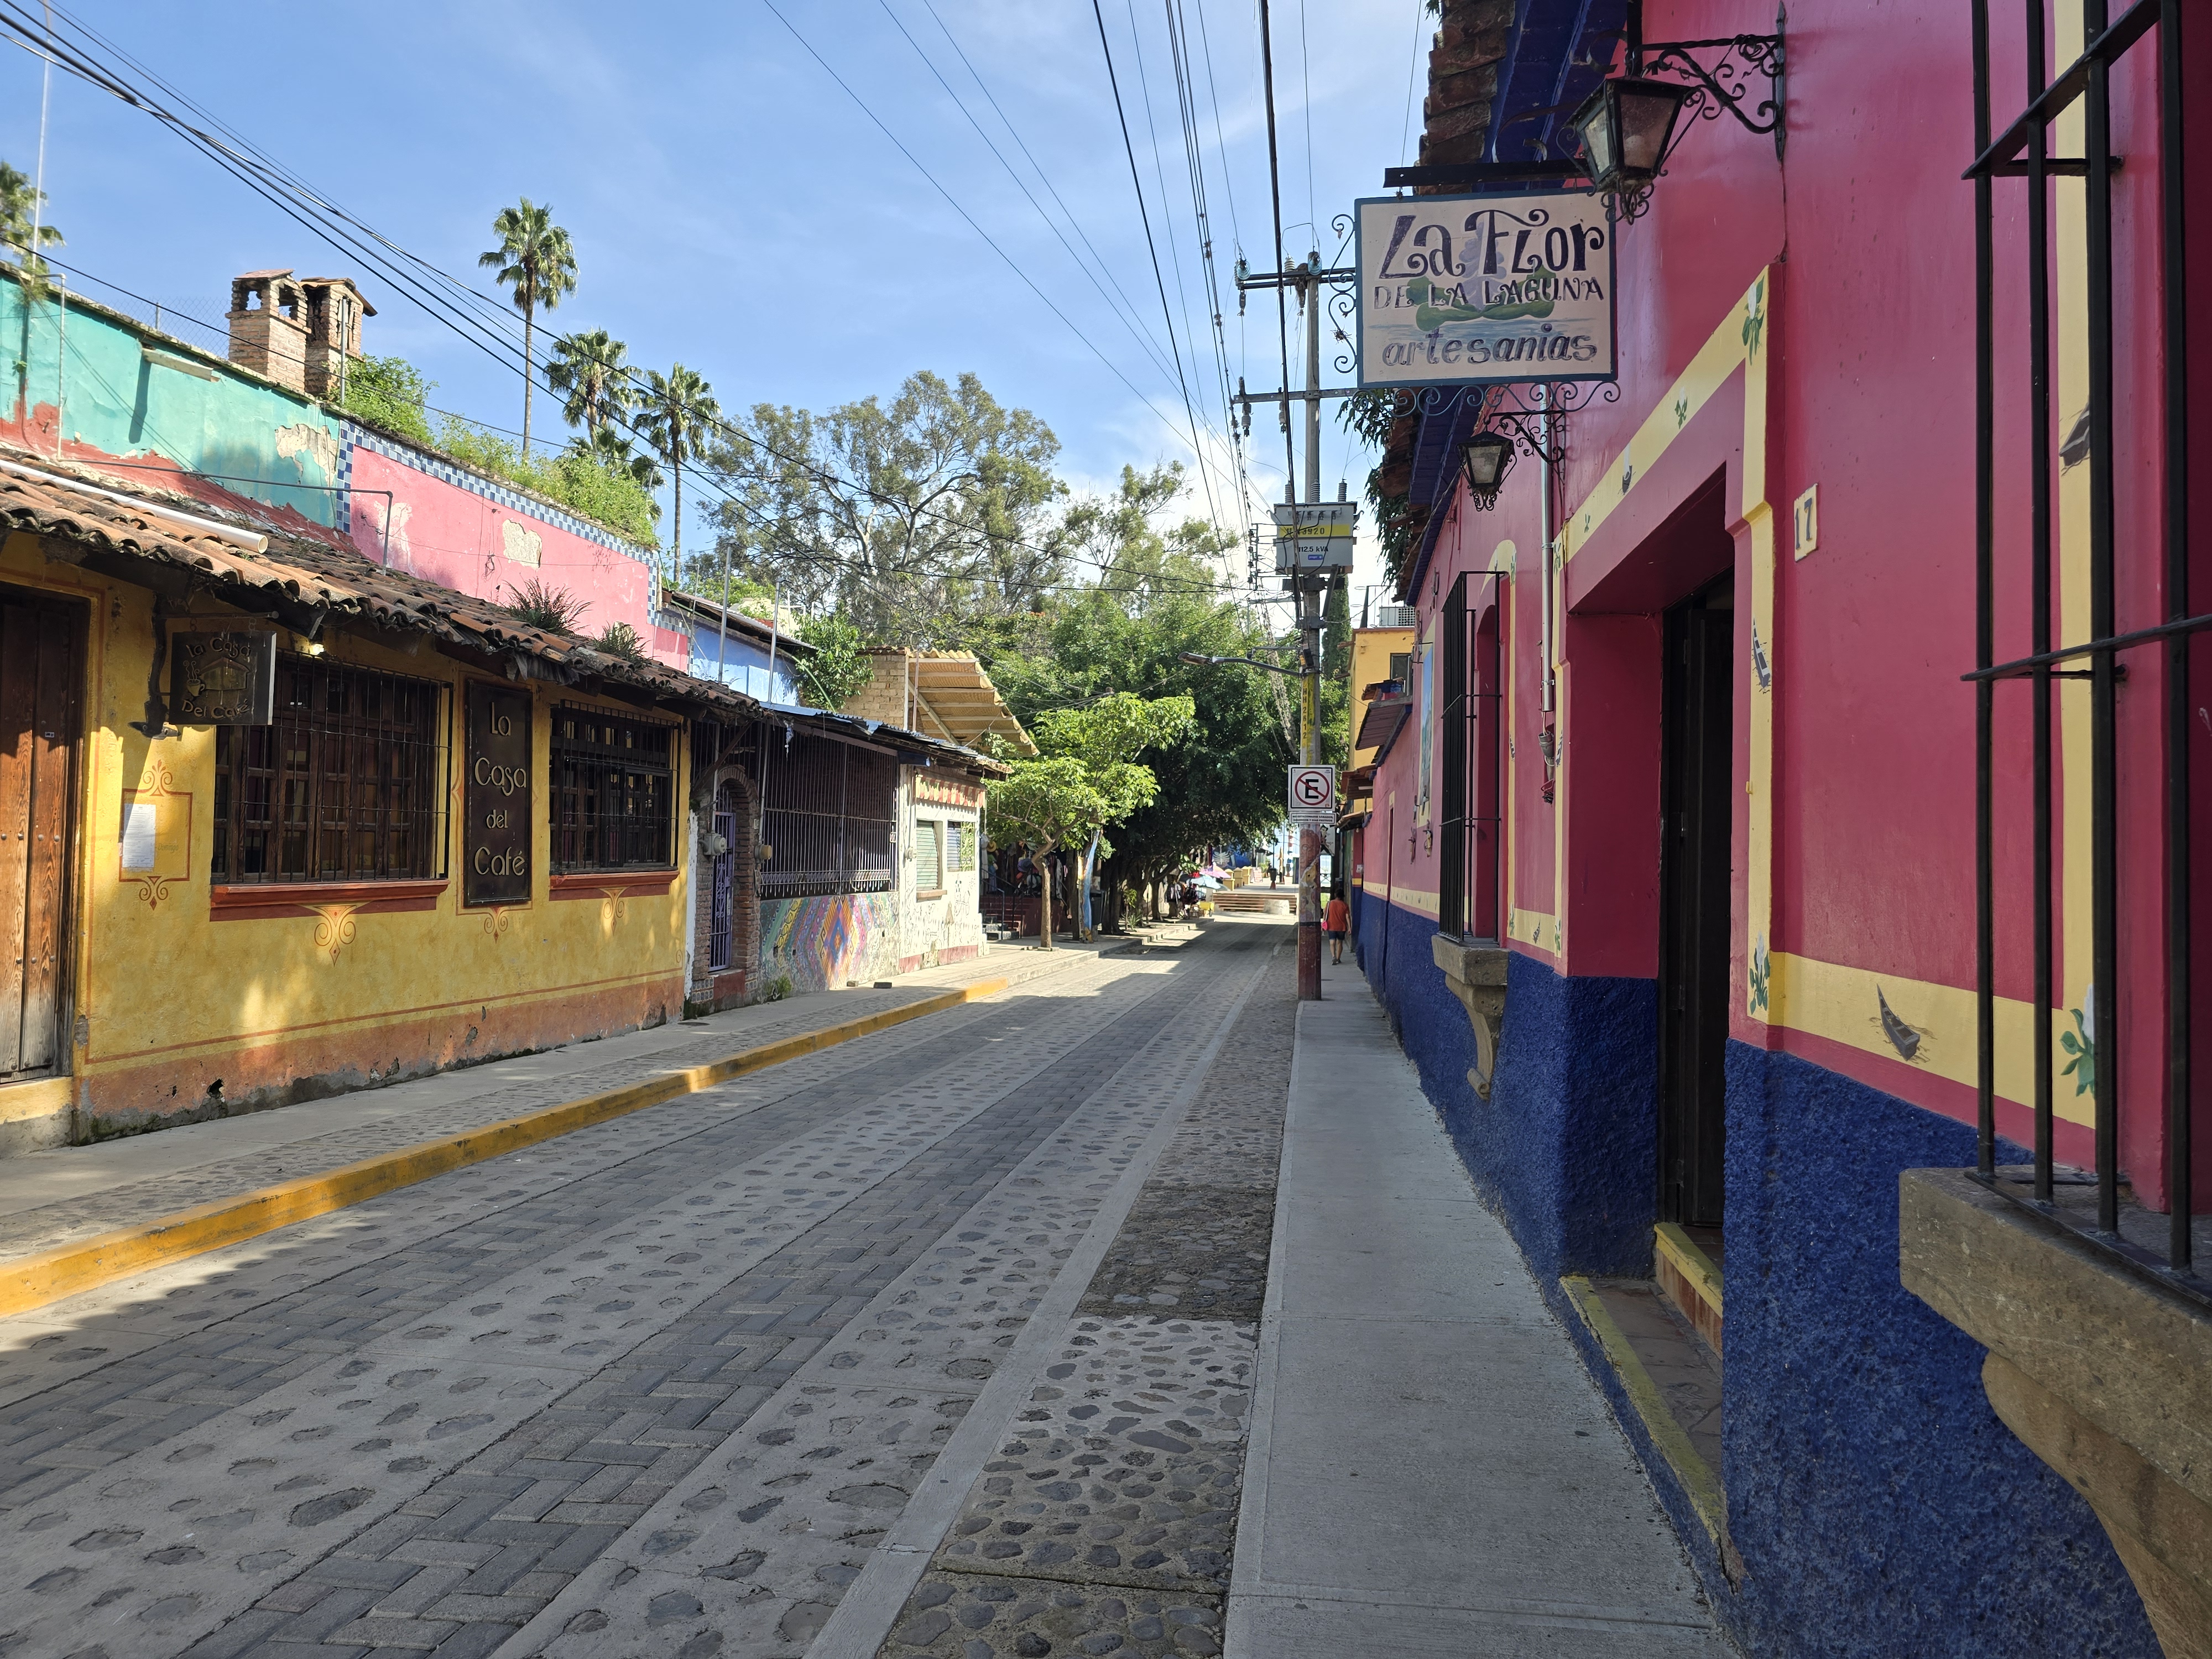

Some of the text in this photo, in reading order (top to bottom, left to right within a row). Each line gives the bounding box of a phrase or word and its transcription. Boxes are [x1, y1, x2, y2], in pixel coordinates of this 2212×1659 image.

[1378, 215, 1465, 279] La
[1373, 276, 1605, 310] DE LA LAGUNA
[1794, 497, 1812, 550] 17
[210, 637, 252, 658] Casa
[181, 700, 207, 717] Del
[474, 757, 526, 796] Casa
[1305, 779, 1319, 799] E
[486, 810, 508, 829] del
[474, 846, 525, 876] Café
